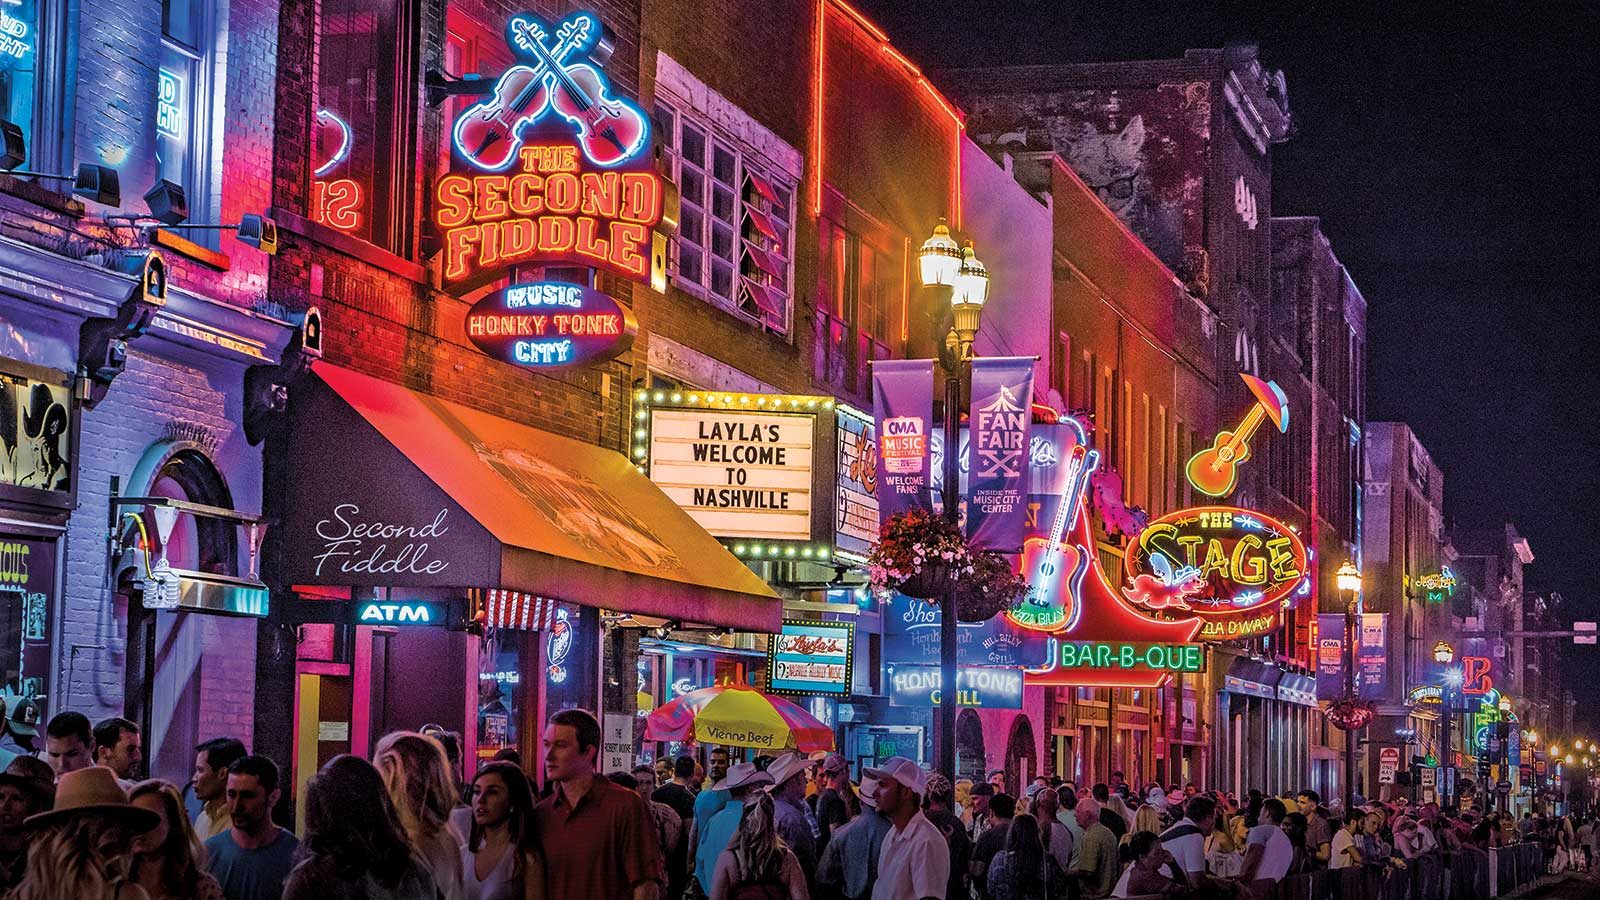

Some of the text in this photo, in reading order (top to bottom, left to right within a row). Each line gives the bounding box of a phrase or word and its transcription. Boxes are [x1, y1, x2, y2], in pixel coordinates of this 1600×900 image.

[520, 146, 577, 172] THE
[437, 172, 660, 226] SECOND
[446, 216, 644, 278] FIDDLE
[506, 285, 582, 309] MUSIC
[470, 314, 620, 335] HONKY TONK
[515, 341, 571, 363] CITY
[888, 421, 918, 435] CMA
[978, 412, 1025, 431] FAN
[699, 421, 780, 443] LAYLA'S
[978, 431, 1024, 449] FAIR
[885, 437, 922, 451] MUSIC
[886, 449, 921, 457] FESTIVAL
[693, 443, 786, 466] WELCOME
[977, 450, 1023, 478] X
[726, 468, 747, 486] TO
[885, 476, 924, 486] WELCOME
[694, 488, 789, 510] NASHVILLE
[973, 496, 1021, 504] MUSIC CITY
[981, 504, 1013, 513] CENTER
[316, 504, 448, 541] Second
[1199, 512, 1232, 529] THE
[313, 540, 449, 576] Fiddle
[1140, 524, 1299, 587] STAGE
[361, 605, 430, 622] ATM
[1322, 640, 1339, 648] CMA
[988, 651, 1015, 664] GRILL
[1061, 643, 1199, 669] BAR-B-QUE
[965, 671, 1020, 693] TONK
[930, 689, 982, 706] GILL
[707, 727, 774, 746] Vienna Beef
